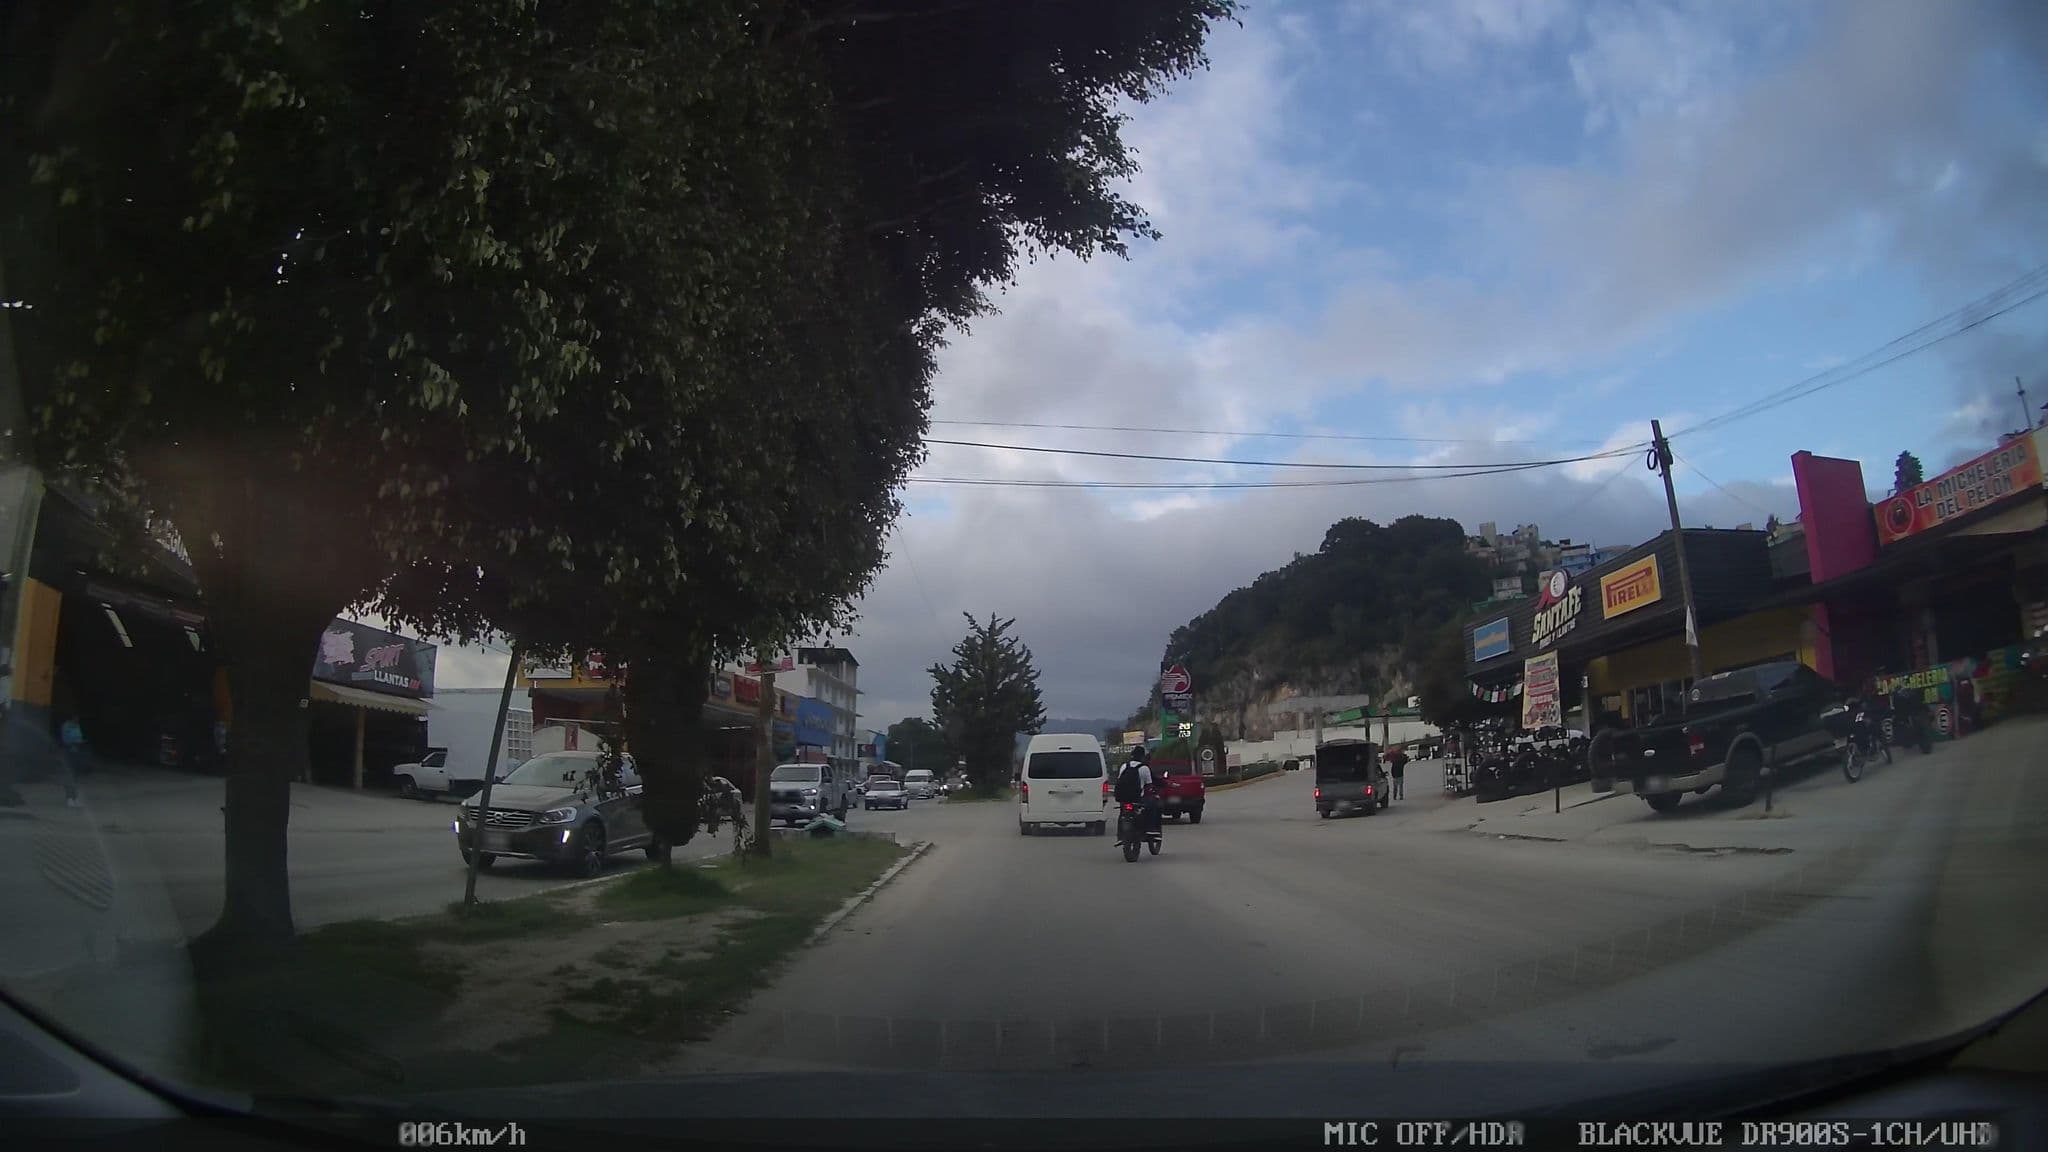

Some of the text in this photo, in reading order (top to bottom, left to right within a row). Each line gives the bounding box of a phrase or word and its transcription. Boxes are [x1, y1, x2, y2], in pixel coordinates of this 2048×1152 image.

[1916, 444, 2027, 507] LA MICHELERIA
[1936, 497, 1963, 519] DEL
[374, 669, 409, 688] LLANTAS
